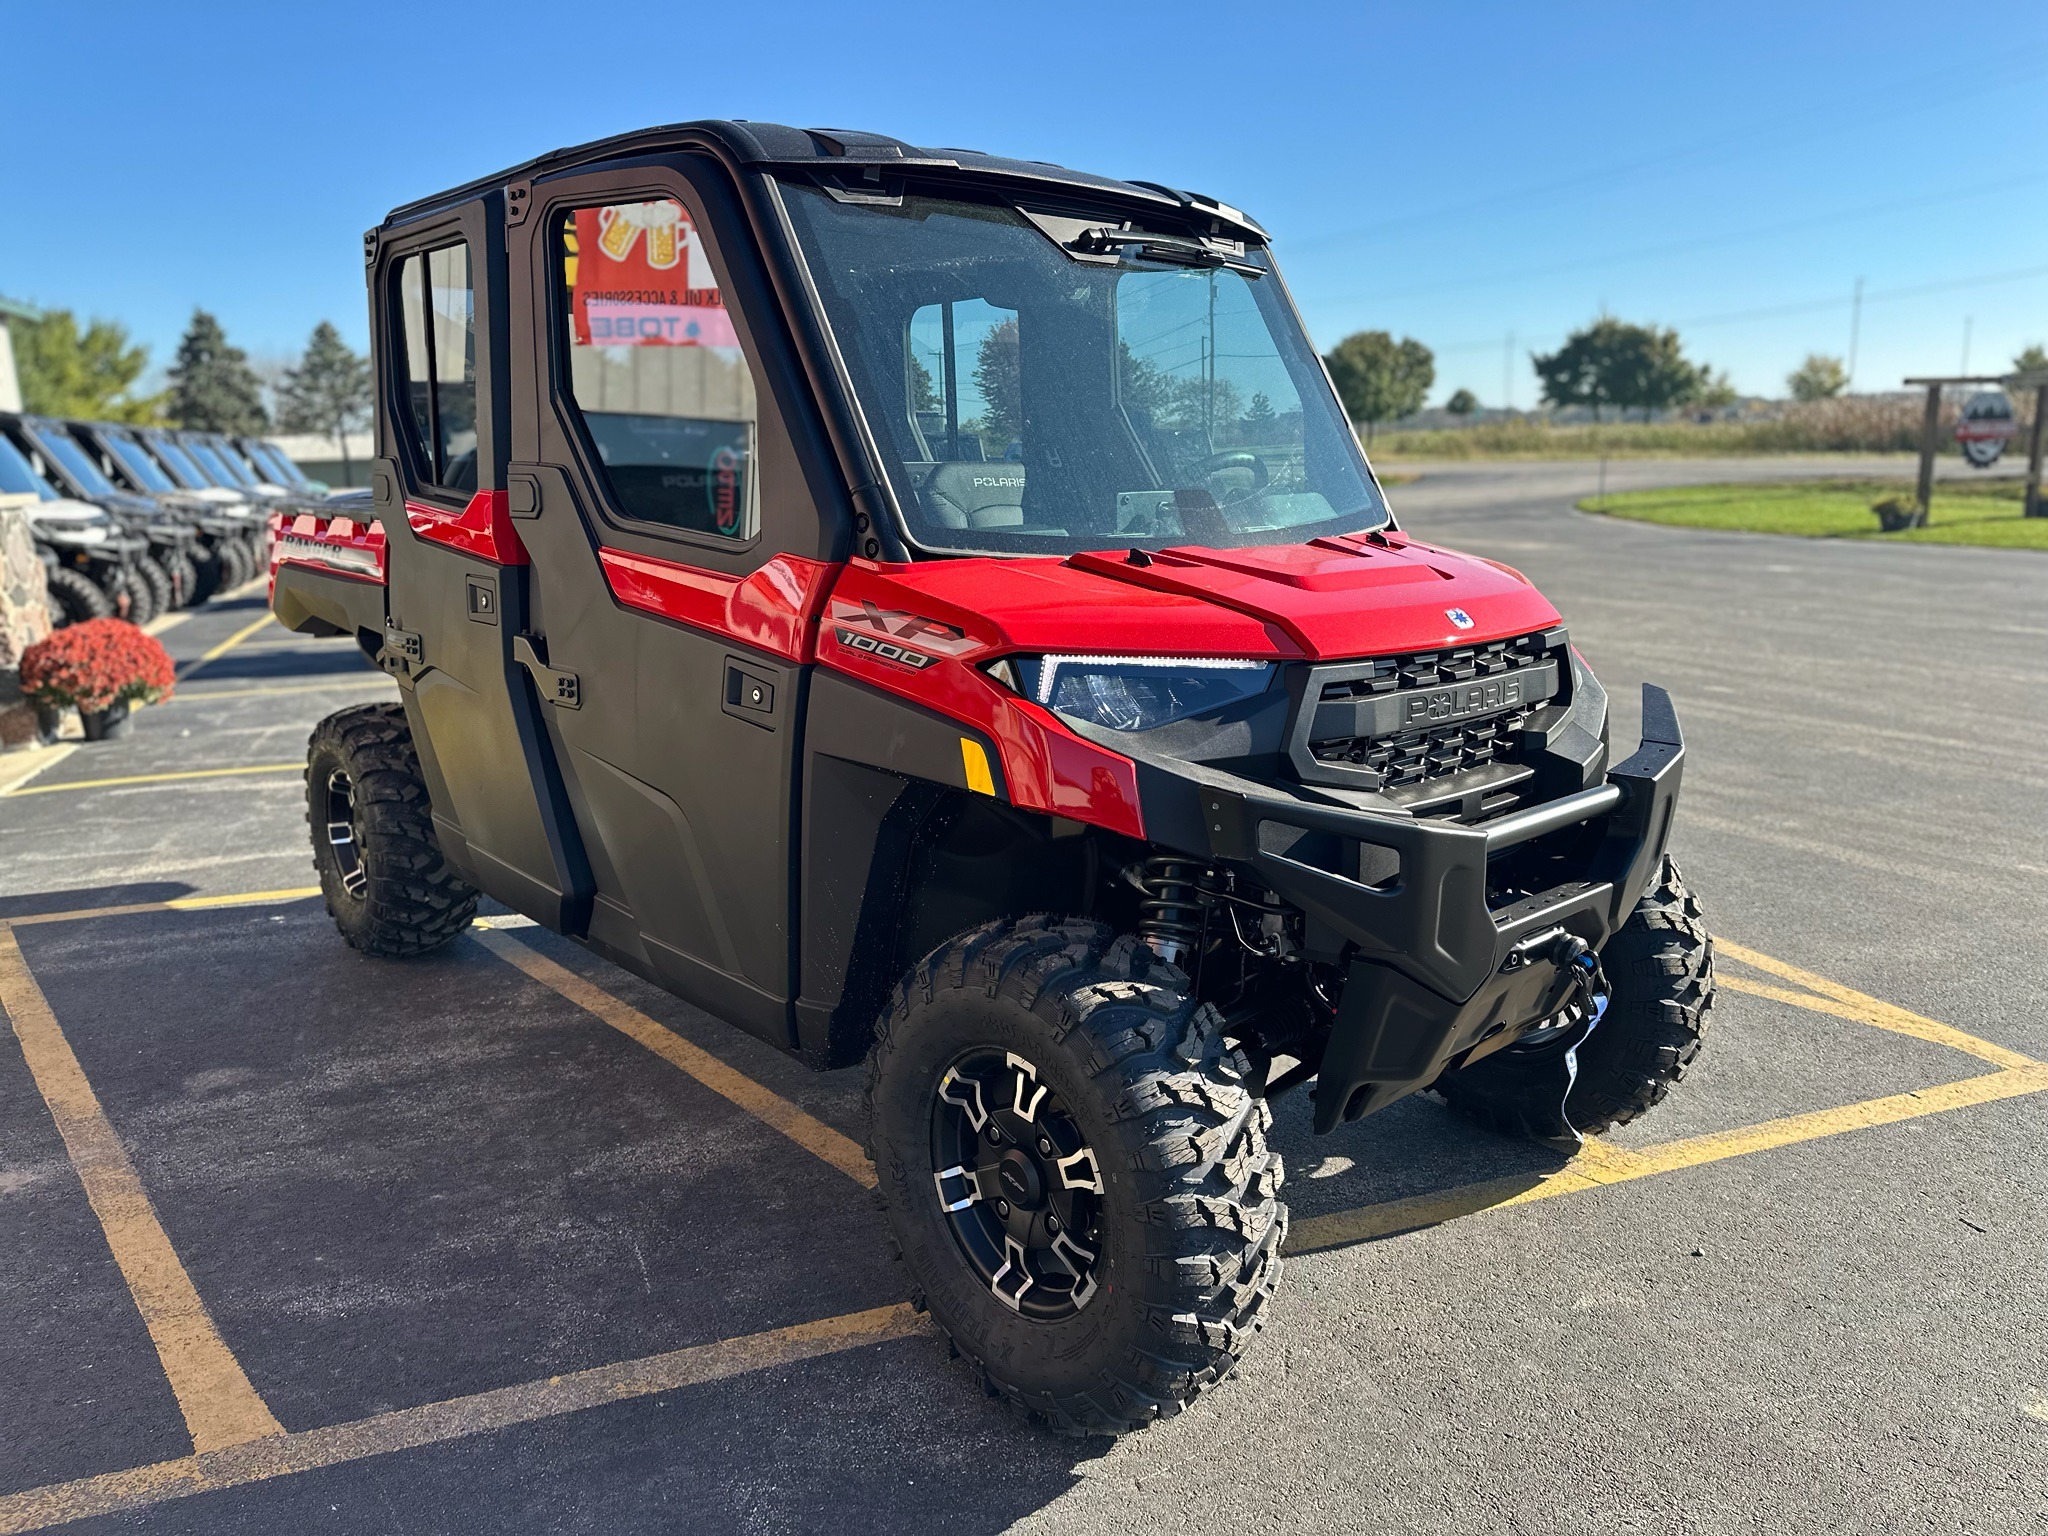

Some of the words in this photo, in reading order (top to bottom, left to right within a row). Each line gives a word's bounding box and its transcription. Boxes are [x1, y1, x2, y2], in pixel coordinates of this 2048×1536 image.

[973, 477, 1026, 488] POLARIS
[835, 598, 966, 642] XP
[842, 632, 929, 668] 1000
[1404, 677, 1520, 724] POLARIS
